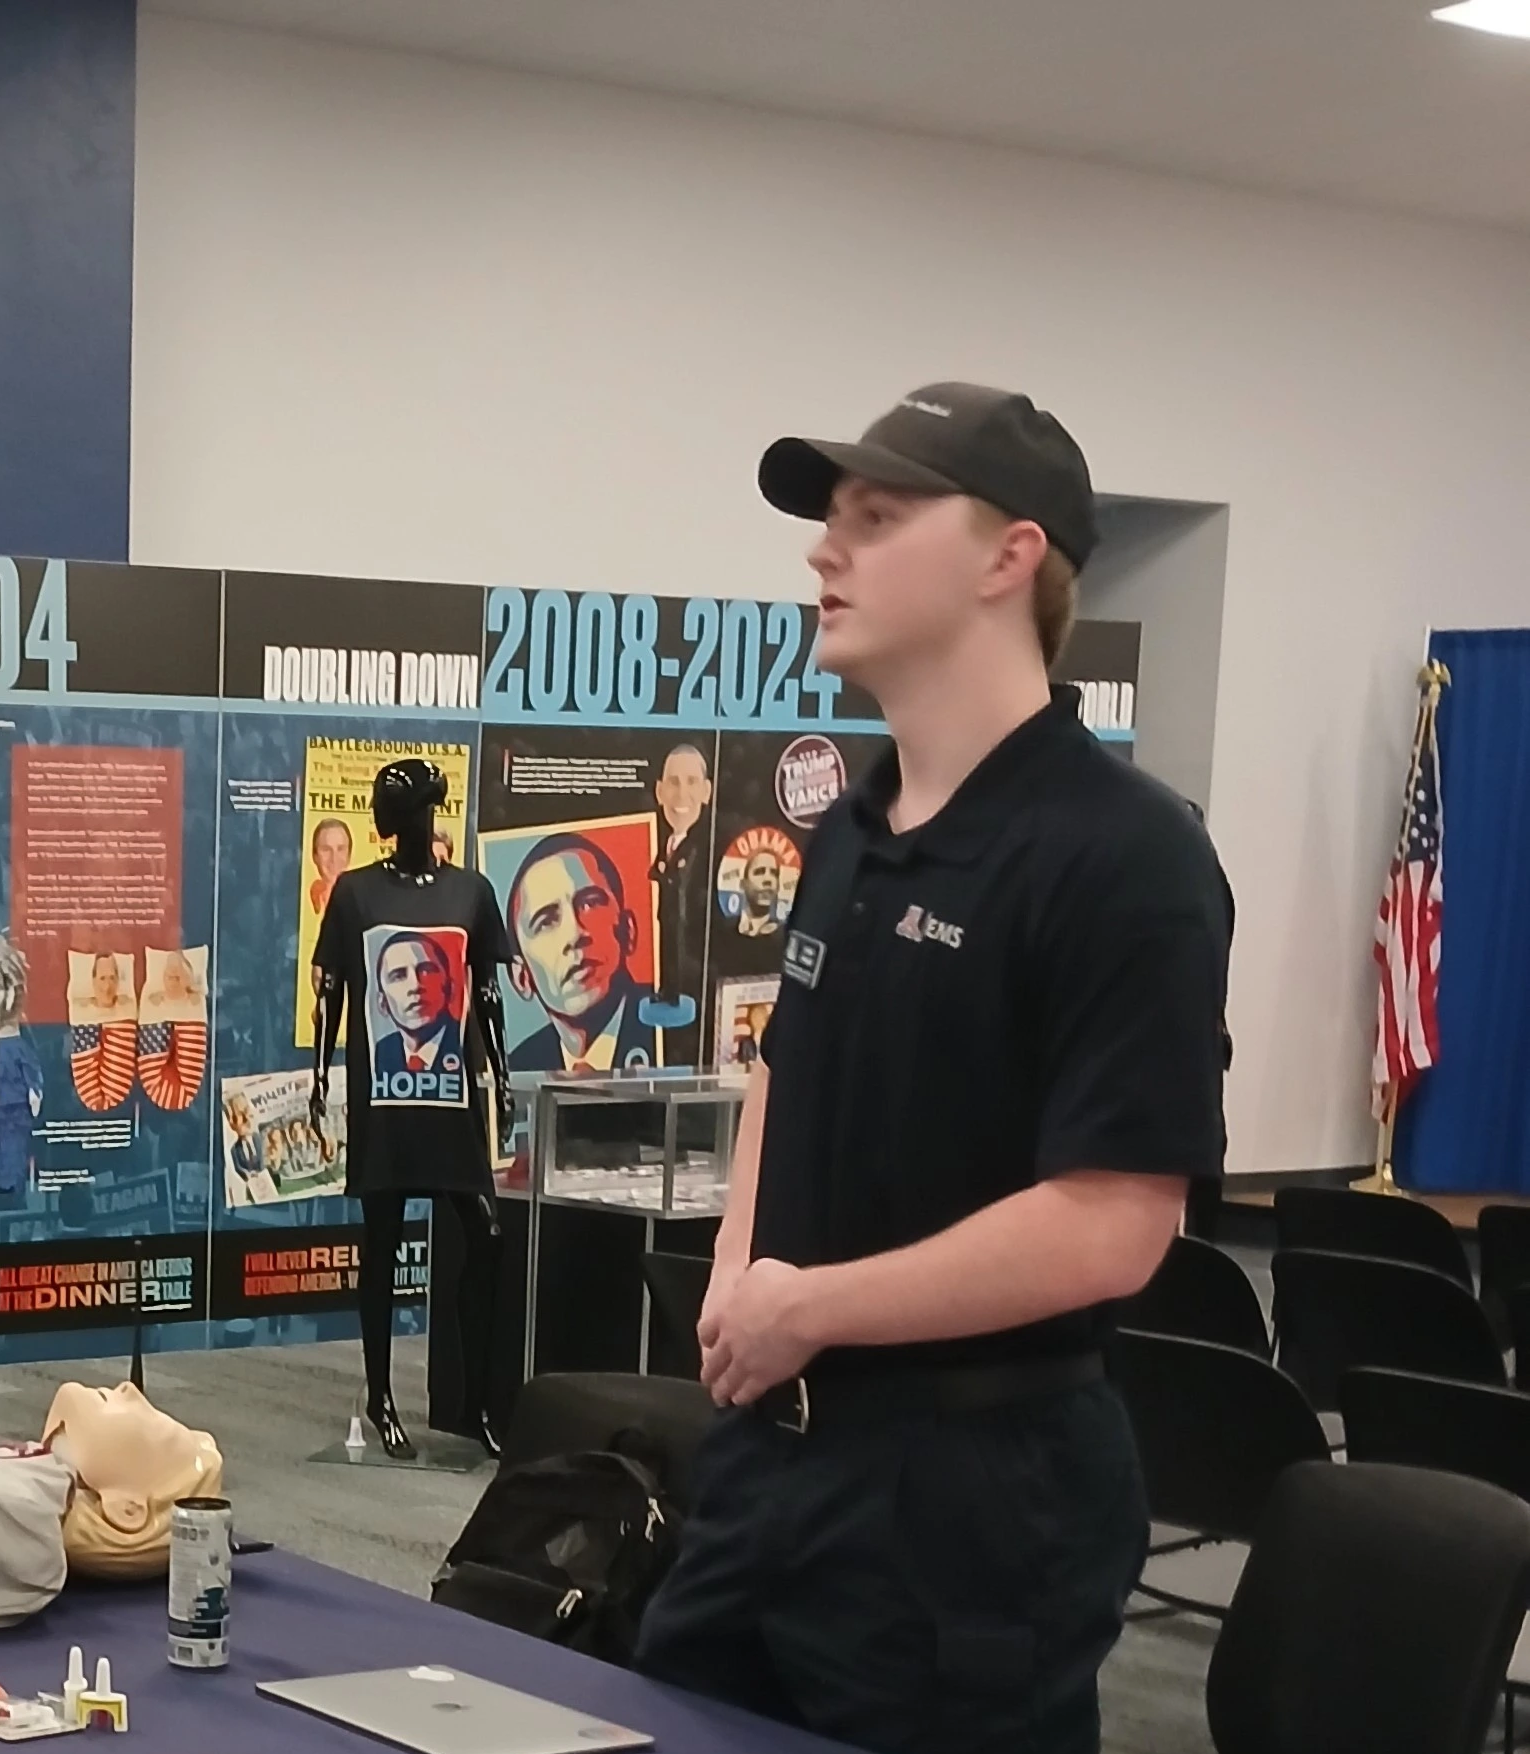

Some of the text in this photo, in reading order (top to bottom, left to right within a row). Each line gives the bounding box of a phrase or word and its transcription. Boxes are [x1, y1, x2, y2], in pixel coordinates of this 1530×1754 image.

[486, 587, 842, 718] 2008-2024
[264, 645, 479, 709] DOUBLING DOWN
[1067, 680, 1134, 731] ORLD
[309, 737, 423, 755] BATTLEGROUND
[782, 753, 835, 779] TRUMP
[309, 792, 346, 808] THE
[784, 782, 839, 809] VANCE
[736, 827, 798, 864] OBAMA
[925, 917, 965, 950] EMS
[372, 1071, 461, 1100] HOPE
[34, 1280, 161, 1310] DINNER
